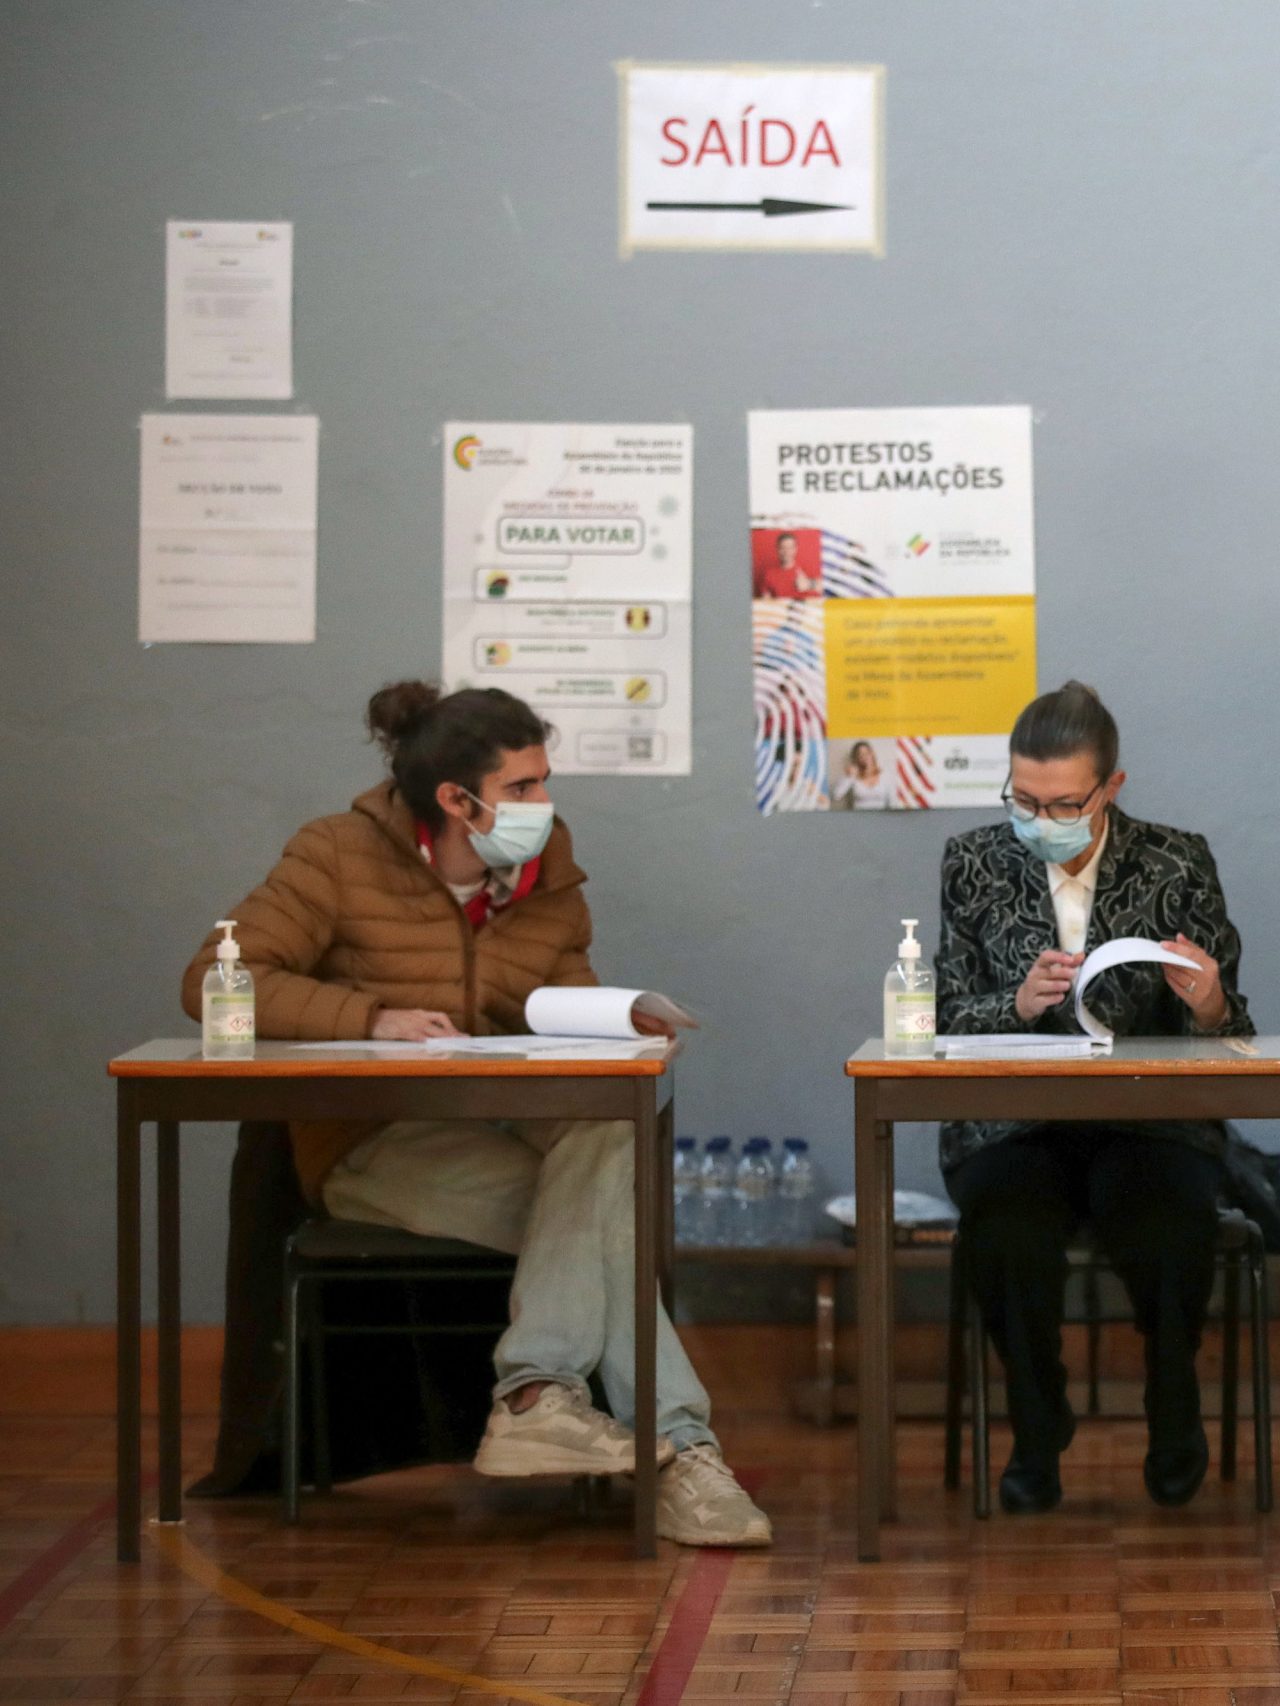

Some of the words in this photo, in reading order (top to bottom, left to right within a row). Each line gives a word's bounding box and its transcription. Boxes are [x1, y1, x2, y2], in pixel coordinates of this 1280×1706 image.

[660, 103, 841, 167] SAÍDA
[778, 442, 932, 466] PROTESTOS
[778, 471, 794, 494] E
[804, 463, 1004, 496] RECLAMAÇÕES
[506, 525, 561, 544] PARA
[566, 525, 635, 544] VOTAR
